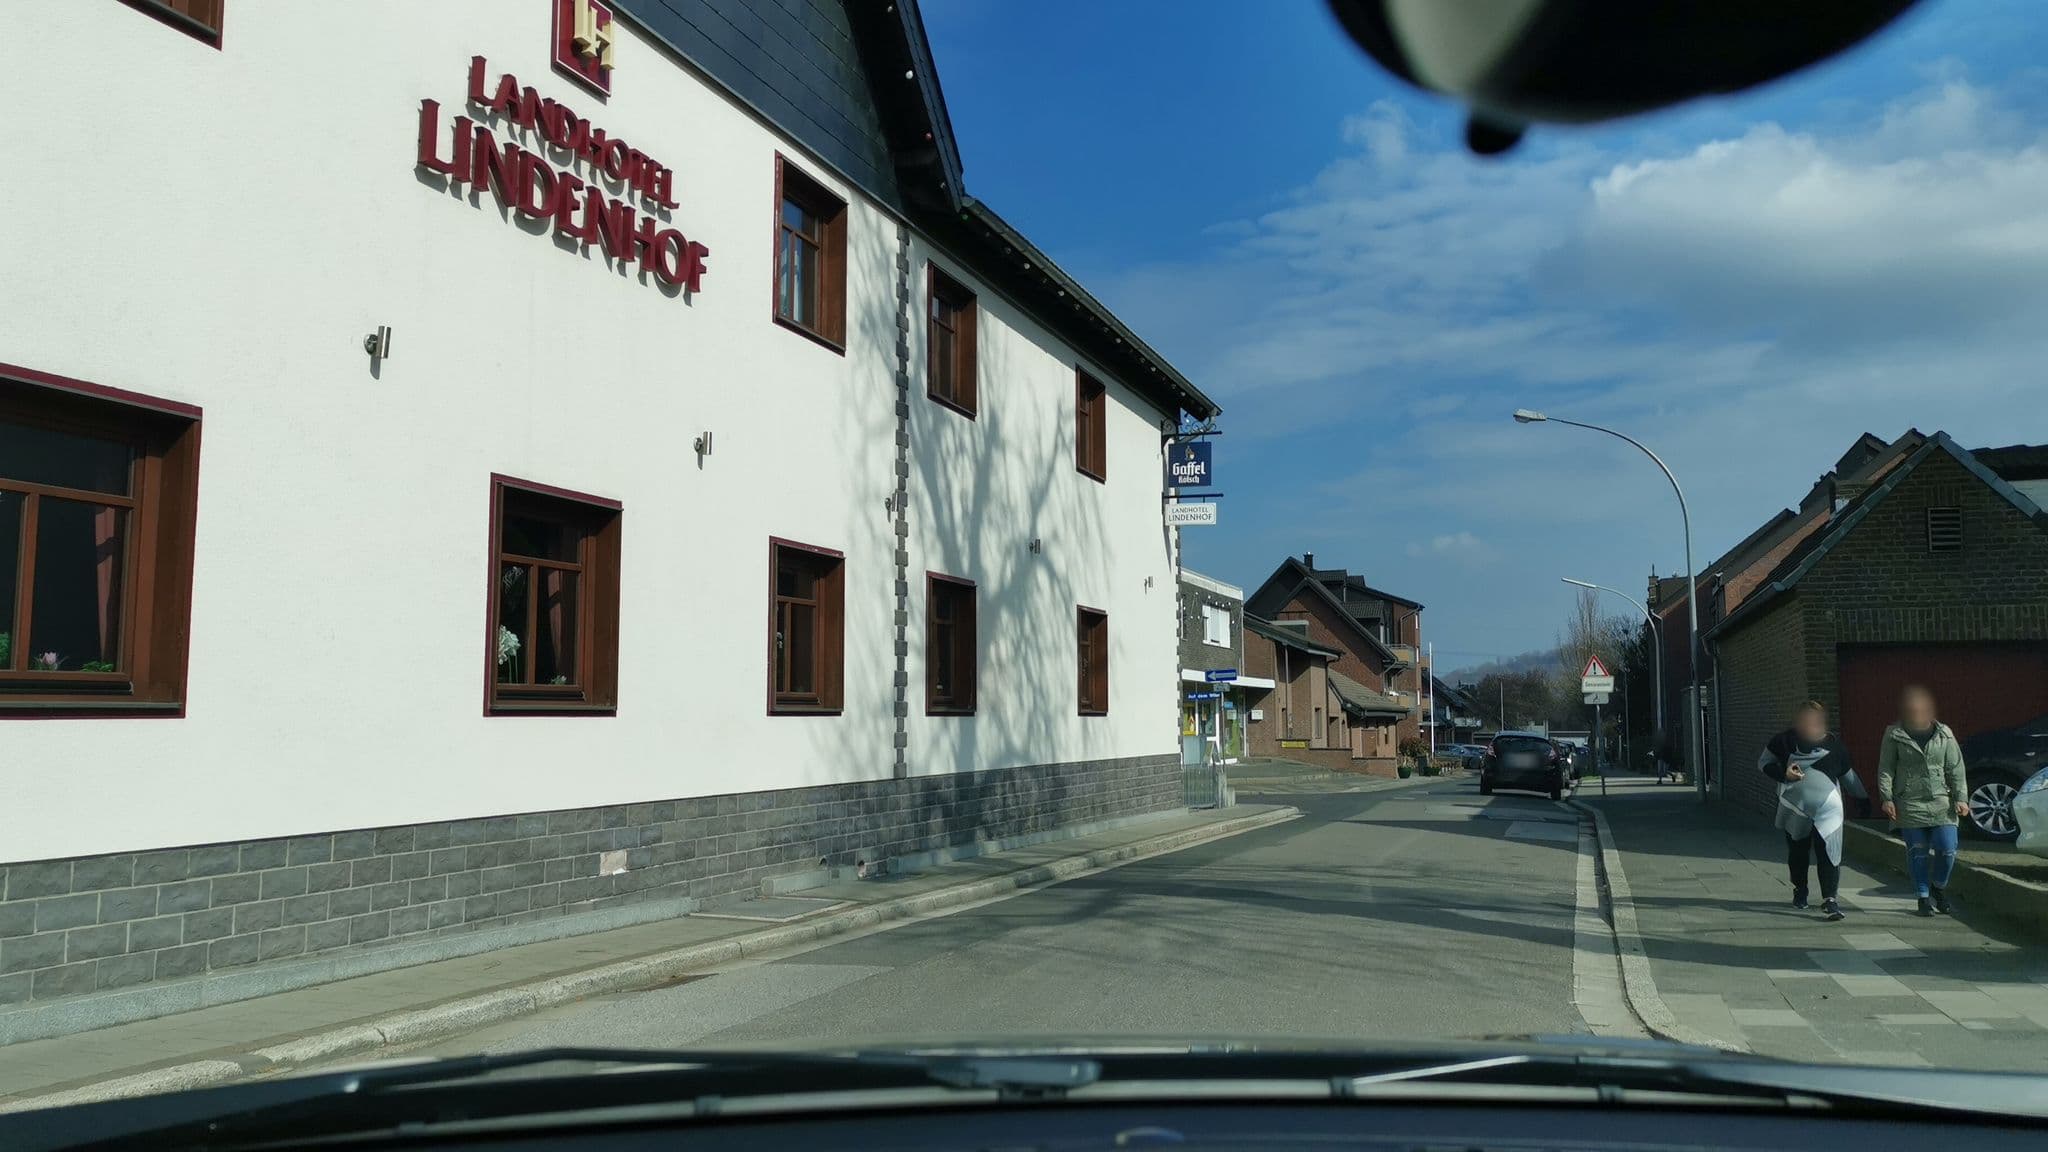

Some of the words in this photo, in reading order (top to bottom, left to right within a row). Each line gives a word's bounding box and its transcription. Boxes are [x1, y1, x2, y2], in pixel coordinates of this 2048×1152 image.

[470, 55, 680, 210] LANDHOTEL
[417, 98, 709, 293] LINDENHOF
[1172, 461, 1206, 476] Gaffel
[1168, 513, 1212, 522] LINDENHOF
